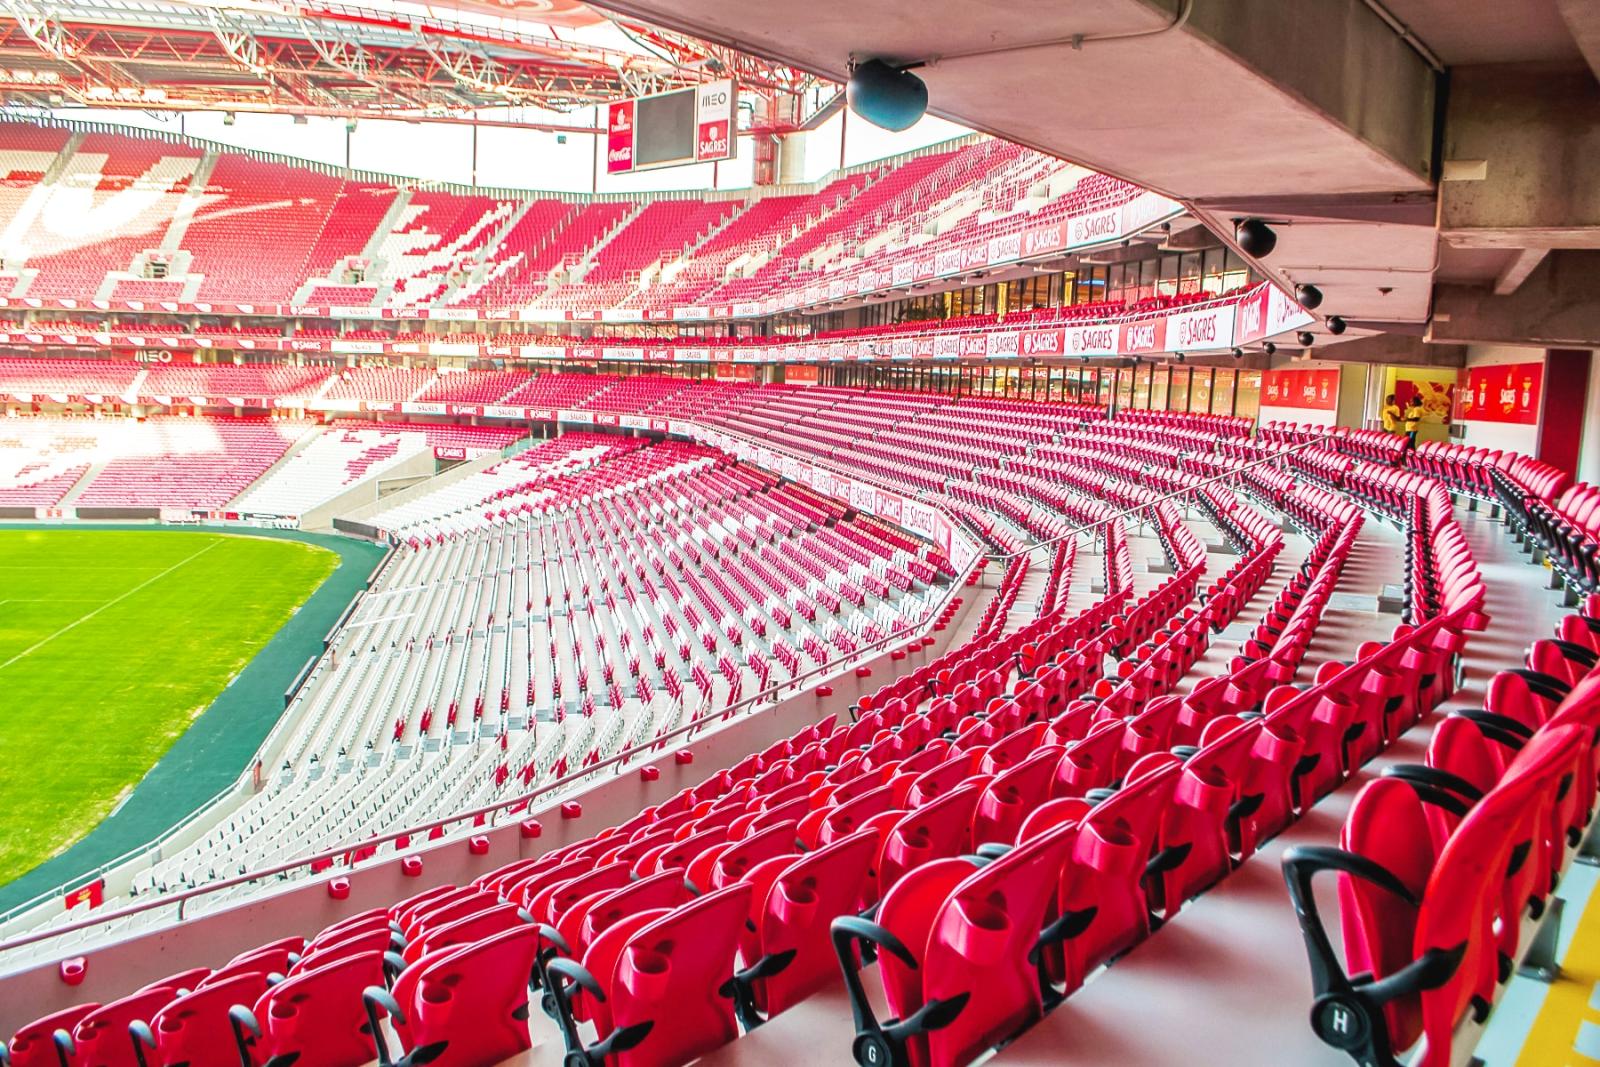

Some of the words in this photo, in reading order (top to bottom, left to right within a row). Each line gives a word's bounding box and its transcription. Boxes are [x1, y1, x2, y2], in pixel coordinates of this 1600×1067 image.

[702, 92, 727, 107] MEO
[699, 138, 727, 156] SAGRES
[1084, 212, 1116, 240] SAGRES
[997, 233, 1020, 258] SAGRES
[1033, 225, 1060, 251] SAGRES
[1081, 329, 1112, 351] SAGRES
[1133, 324, 1155, 350] SAGRES
[1187, 314, 1216, 345] SAGRES
[940, 337, 958, 355] SAGRES
[966, 335, 987, 355] SAGRES
[995, 332, 1018, 354] SAGRES
[1031, 331, 1059, 353] SAGRES
[134, 350, 173, 363] MEO
[910, 506, 932, 534] SAGRES
[1333, 1009, 1348, 1034] H
[869, 1045, 877, 1063] G
